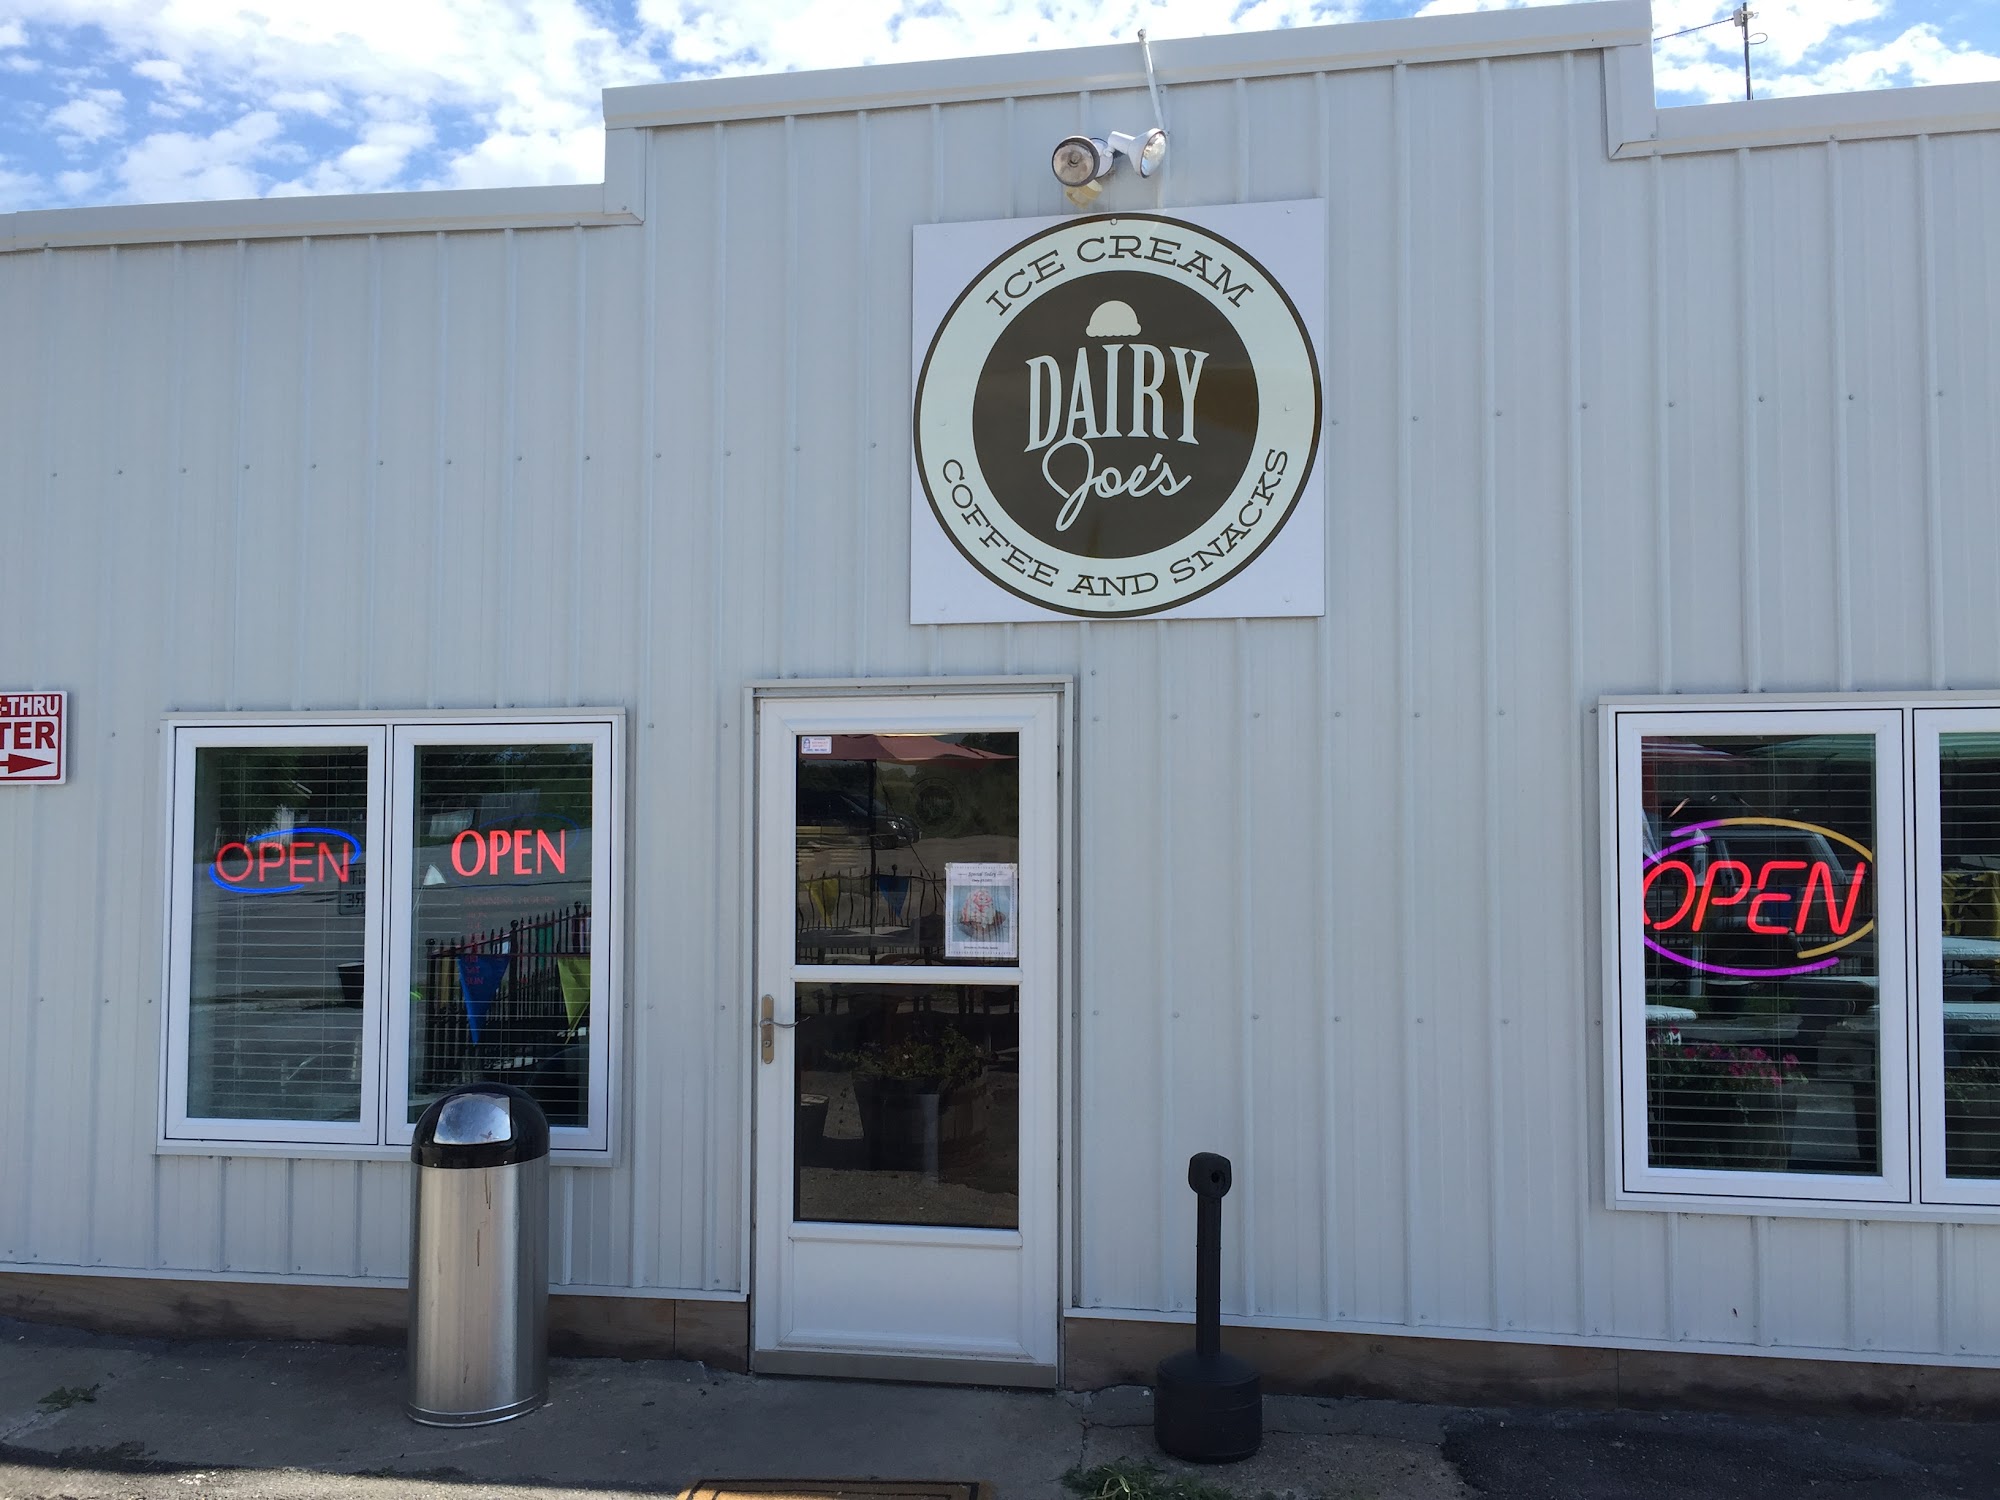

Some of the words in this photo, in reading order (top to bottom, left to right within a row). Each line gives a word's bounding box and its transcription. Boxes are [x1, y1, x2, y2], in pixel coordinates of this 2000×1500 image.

[986, 249, 1065, 316] ICE
[1076, 235, 1254, 308] CREAM
[1024, 343, 1210, 453] DAIRY
[942, 459, 1059, 587] COFFEE
[1067, 572, 1159, 596] AND
[1169, 449, 1288, 583] SNACKS
[1042, 437, 1192, 532] Joe's
[0, 696, 59, 716] -THRU
[216, 842, 349, 882] OPEN
[451, 829, 566, 877] OPEN
[1643, 860, 1865, 935] OPEN
